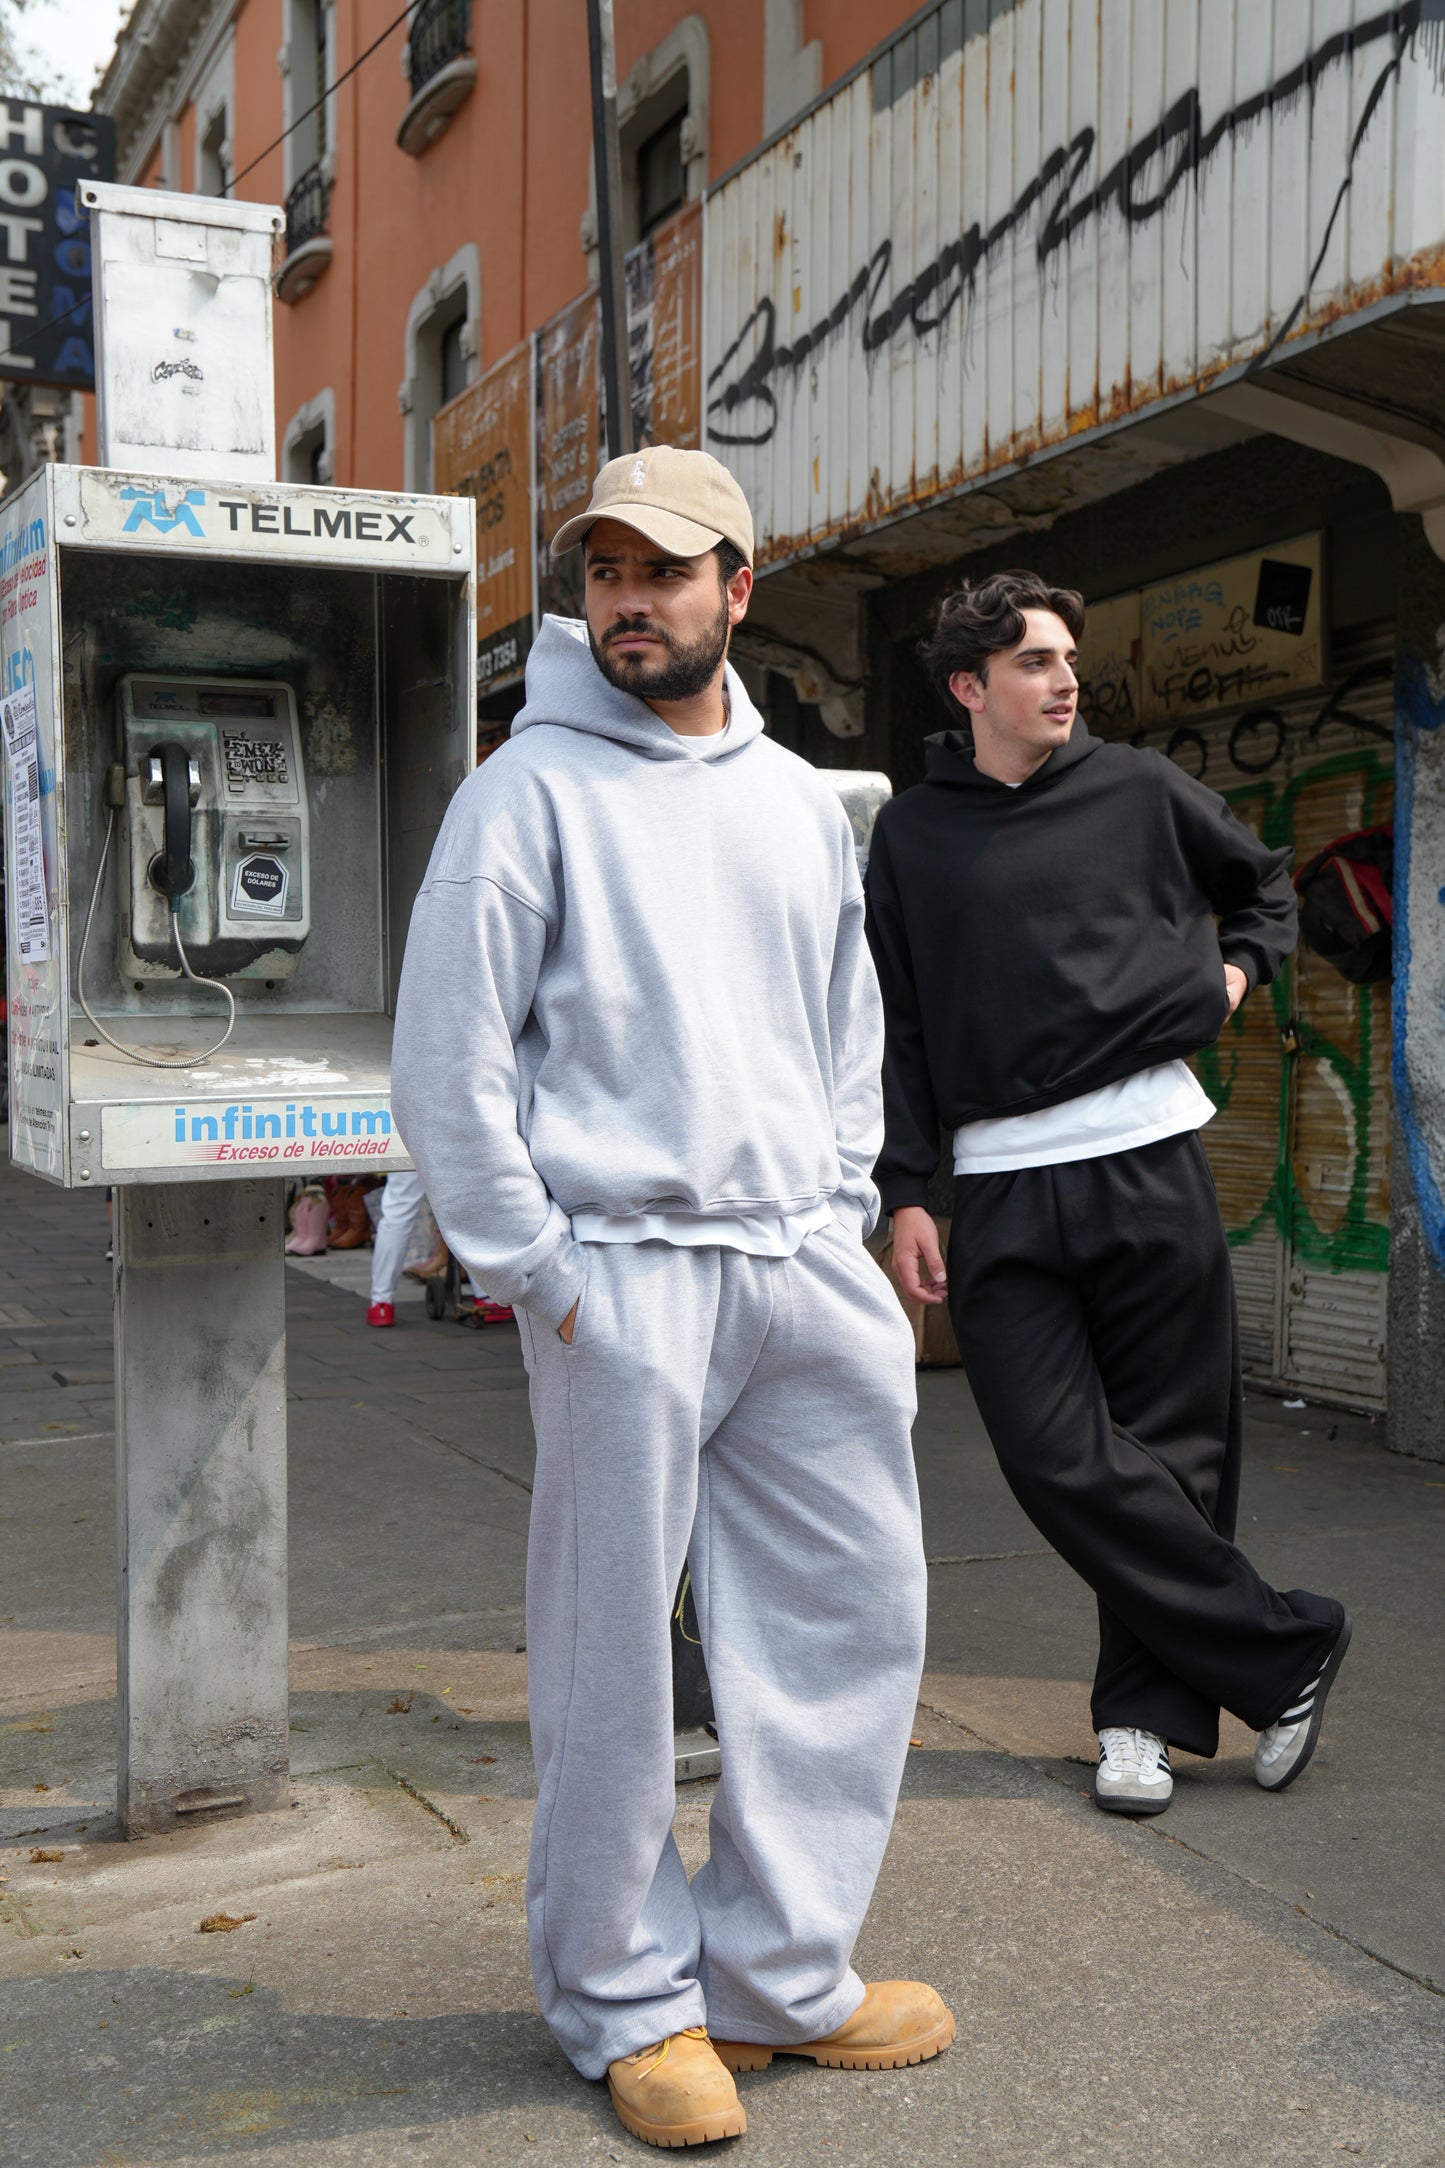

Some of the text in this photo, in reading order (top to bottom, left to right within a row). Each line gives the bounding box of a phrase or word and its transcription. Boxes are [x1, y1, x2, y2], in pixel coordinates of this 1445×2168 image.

[0, 104, 48, 369] HOTEL
[218, 501, 417, 544] TELMEX
[245, 870, 279, 882] EXCESO DE
[174, 1104, 391, 1143] infinitum
[216, 1138, 390, 1161] Exceso de Velocidad
